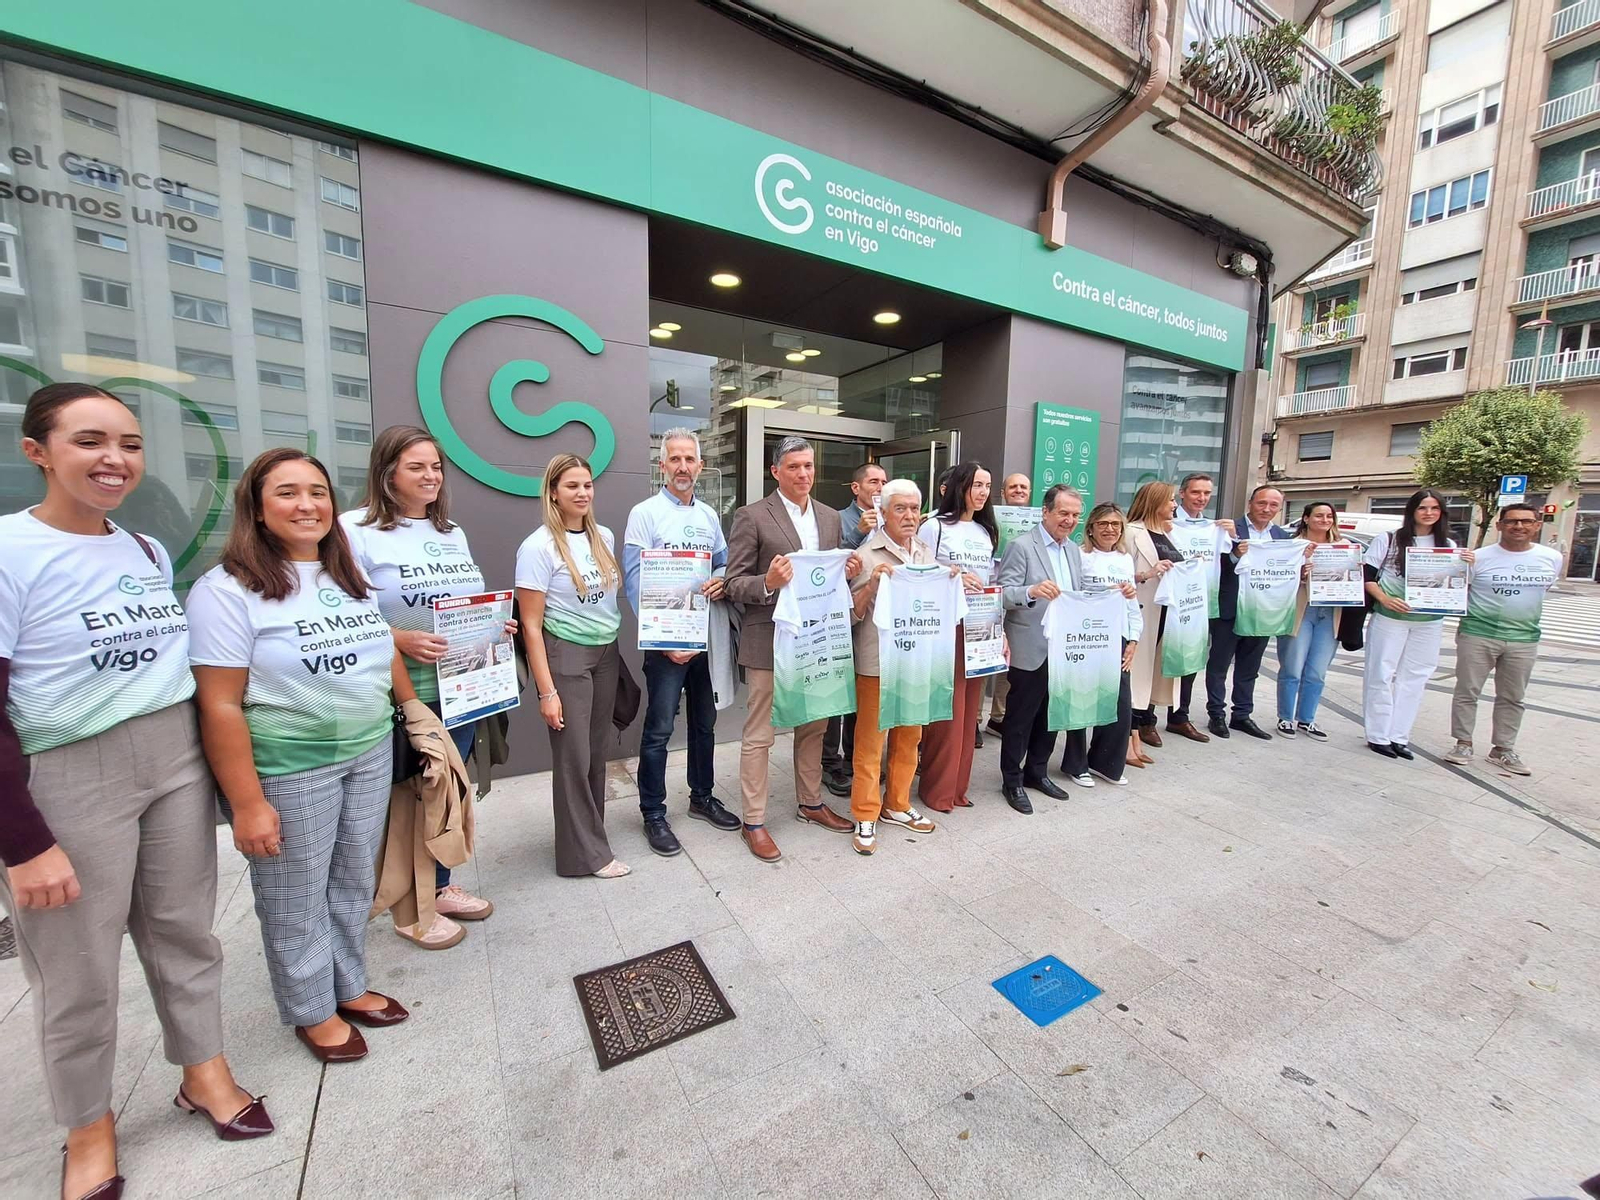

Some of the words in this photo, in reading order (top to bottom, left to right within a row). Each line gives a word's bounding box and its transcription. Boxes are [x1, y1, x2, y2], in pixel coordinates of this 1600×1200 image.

[8, 144, 49, 170] el
[58, 150, 189, 198] Cáncer
[0, 181, 122, 219] somos
[131, 206, 198, 233] uno
[825, 180, 902, 218] asociación
[904, 207, 963, 238] española
[825, 202, 873, 229] contra
[875, 218, 889, 234] el
[891, 224, 936, 249] cáncer
[824, 225, 844, 243] en
[846, 228, 879, 254] Vigo
[1052, 271, 1100, 303] Contra
[1102, 288, 1116, 308] el
[1117, 295, 1162, 323] cáncer,
[1163, 307, 1195, 332] todos
[1195, 317, 1228, 343] juntos
[1506, 477, 1522, 491] P
[949, 552, 963, 561] En
[964, 552, 992, 563] March
[398, 564, 426, 579] En
[1492, 574, 1508, 582] En
[1511, 574, 1552, 582] Marcha
[401, 580, 440, 591] contra
[441, 578, 450, 586] el
[451, 576, 480, 584] cáncer
[1249, 582, 1271, 591] Vigo
[576, 591, 605, 605] Vigo
[1492, 587, 1521, 597] Vigo
[438, 597, 472, 609] RUNRUN
[80, 611, 124, 632] En
[123, 602, 184, 623] Marc
[294, 619, 325, 637] En
[323, 609, 386, 632] March
[438, 612, 456, 621] Vigo
[438, 620, 463, 628] contra
[470, 613, 493, 623] cancro
[894, 618, 906, 629] En
[1179, 614, 1191, 625] Vigo
[90, 630, 143, 648] contra
[146, 626, 159, 638] el
[161, 622, 190, 636] cánc
[300, 637, 342, 653] contra
[344, 632, 355, 644] el
[356, 629, 391, 642] cáncer
[1066, 633, 1077, 643] En
[1078, 632, 1109, 642] Marcha
[90, 647, 158, 672] Vigo
[301, 652, 358, 675] Vigo
[1065, 651, 1085, 663] Vigo
